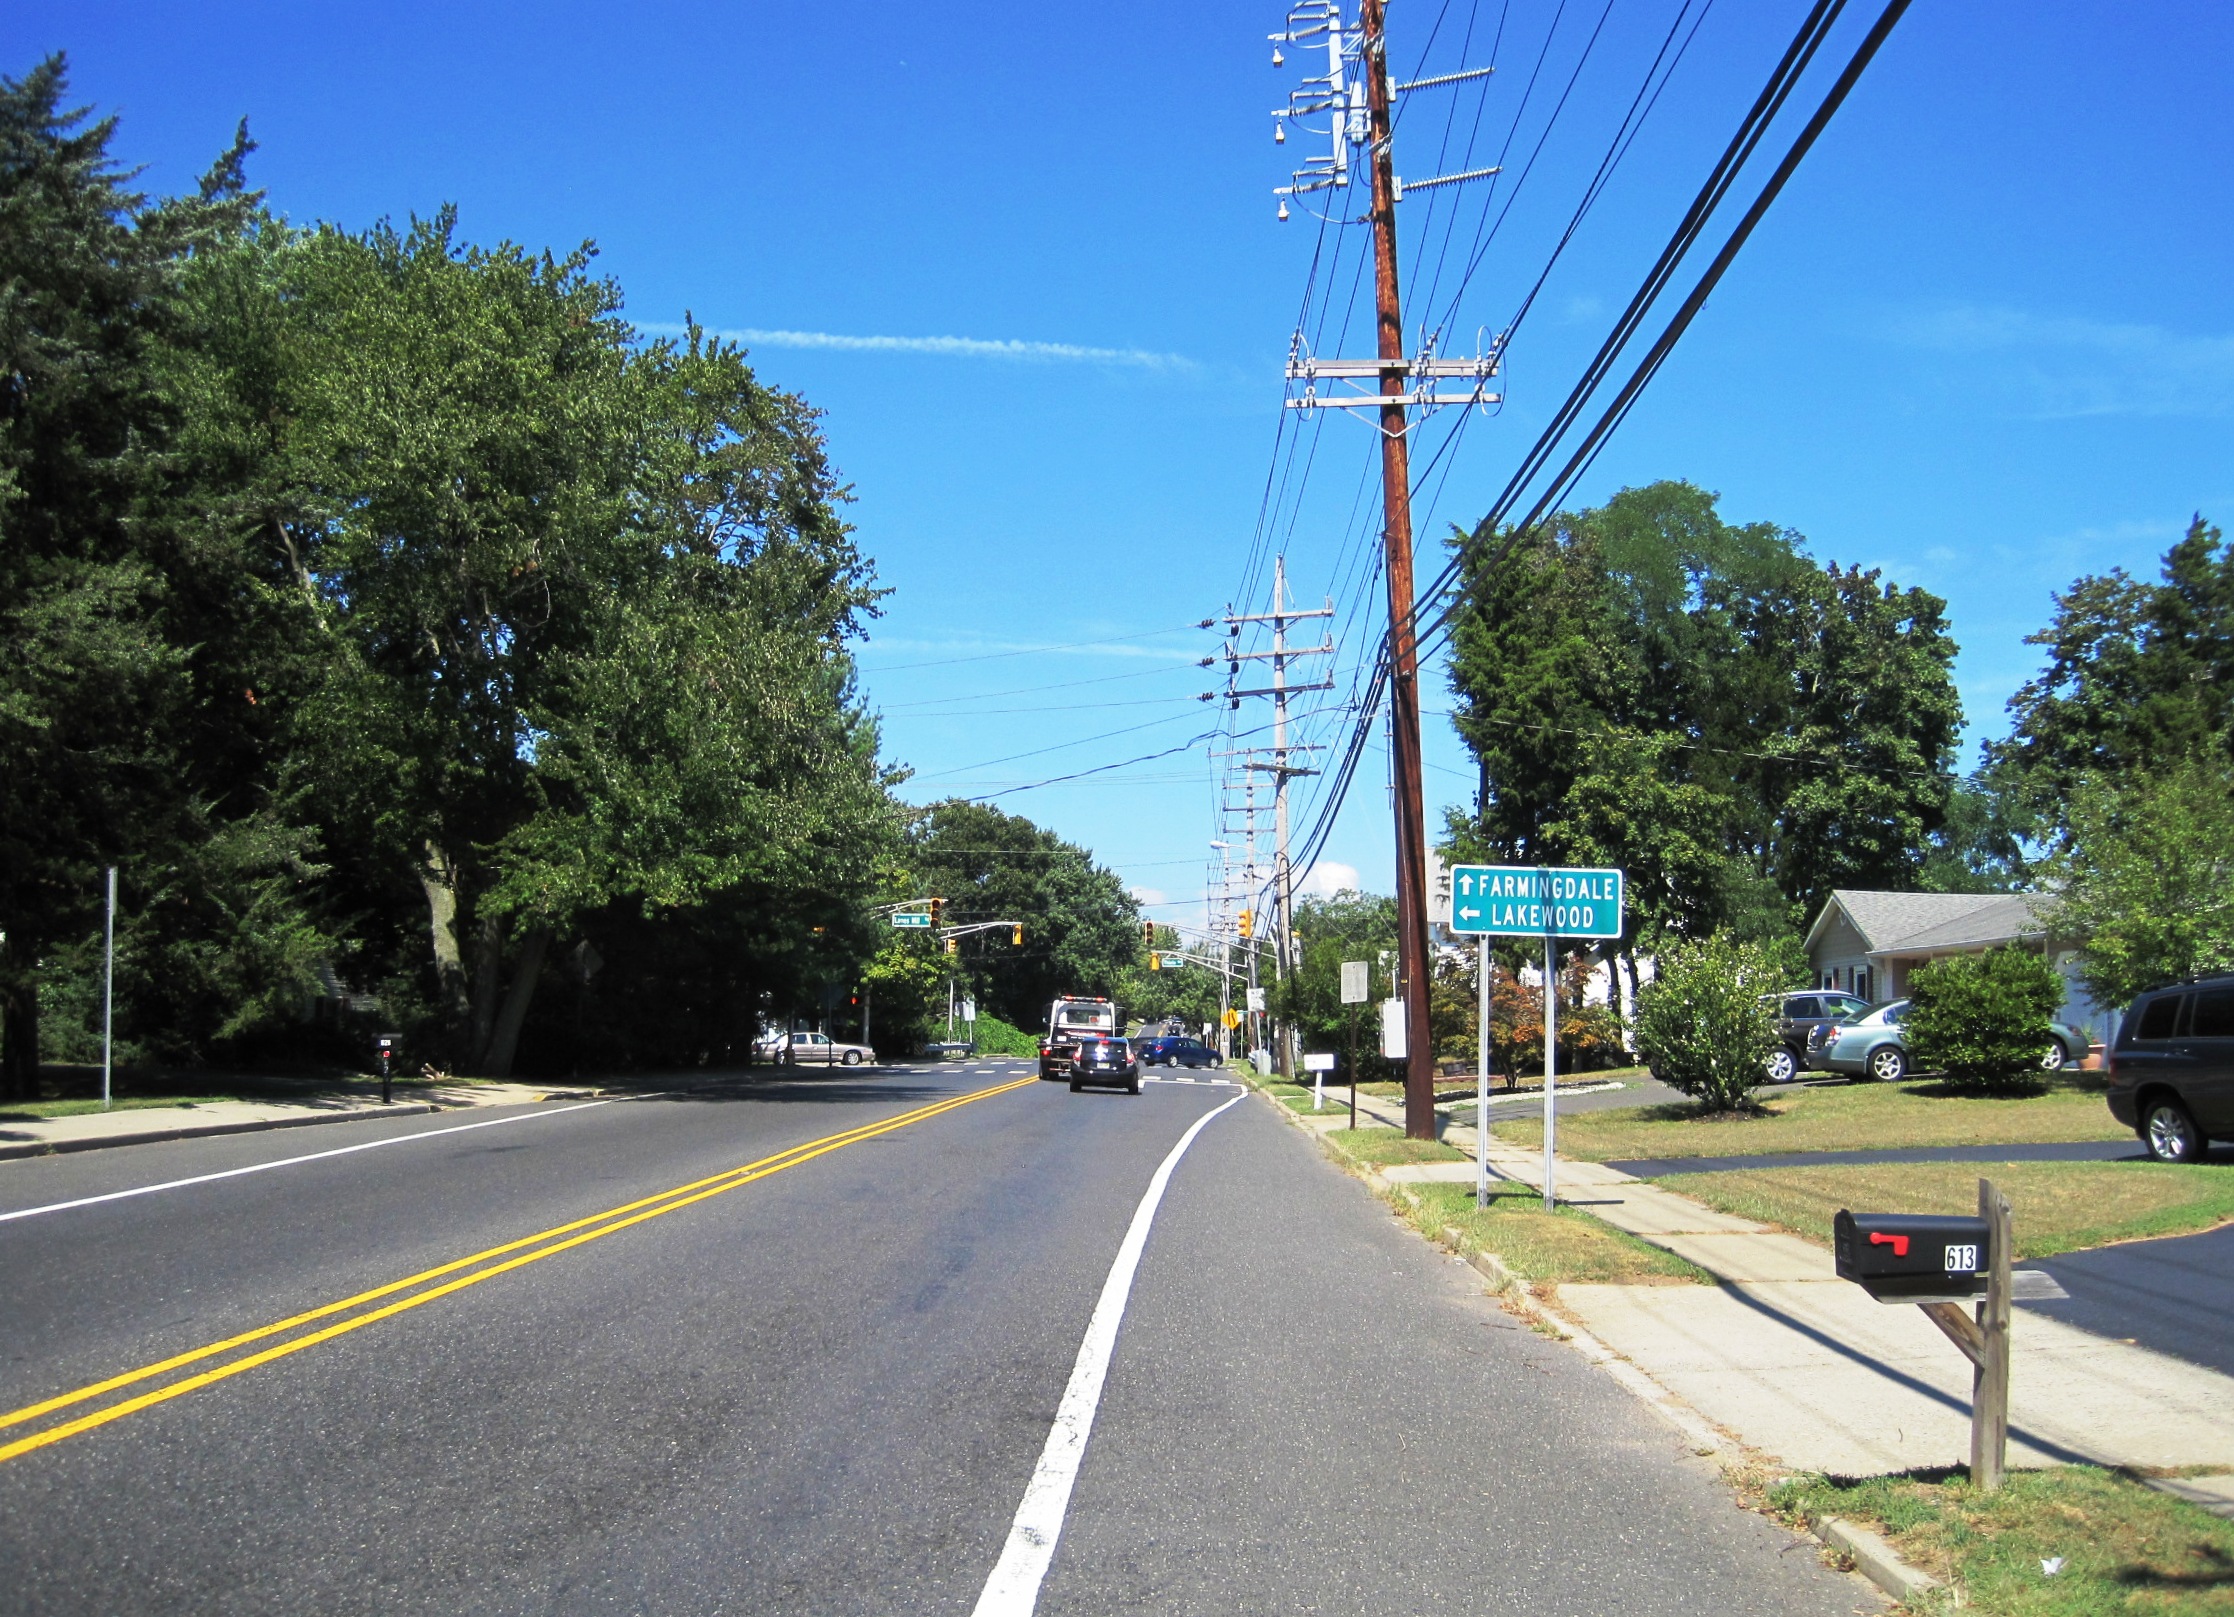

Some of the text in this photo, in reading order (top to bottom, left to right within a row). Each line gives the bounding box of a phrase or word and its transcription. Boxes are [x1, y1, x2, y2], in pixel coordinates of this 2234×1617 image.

[1479, 874, 1614, 900] FARMINGDALE
[1492, 904, 1593, 928] LAKEWOOD
[1946, 1247, 1974, 1269] 613
